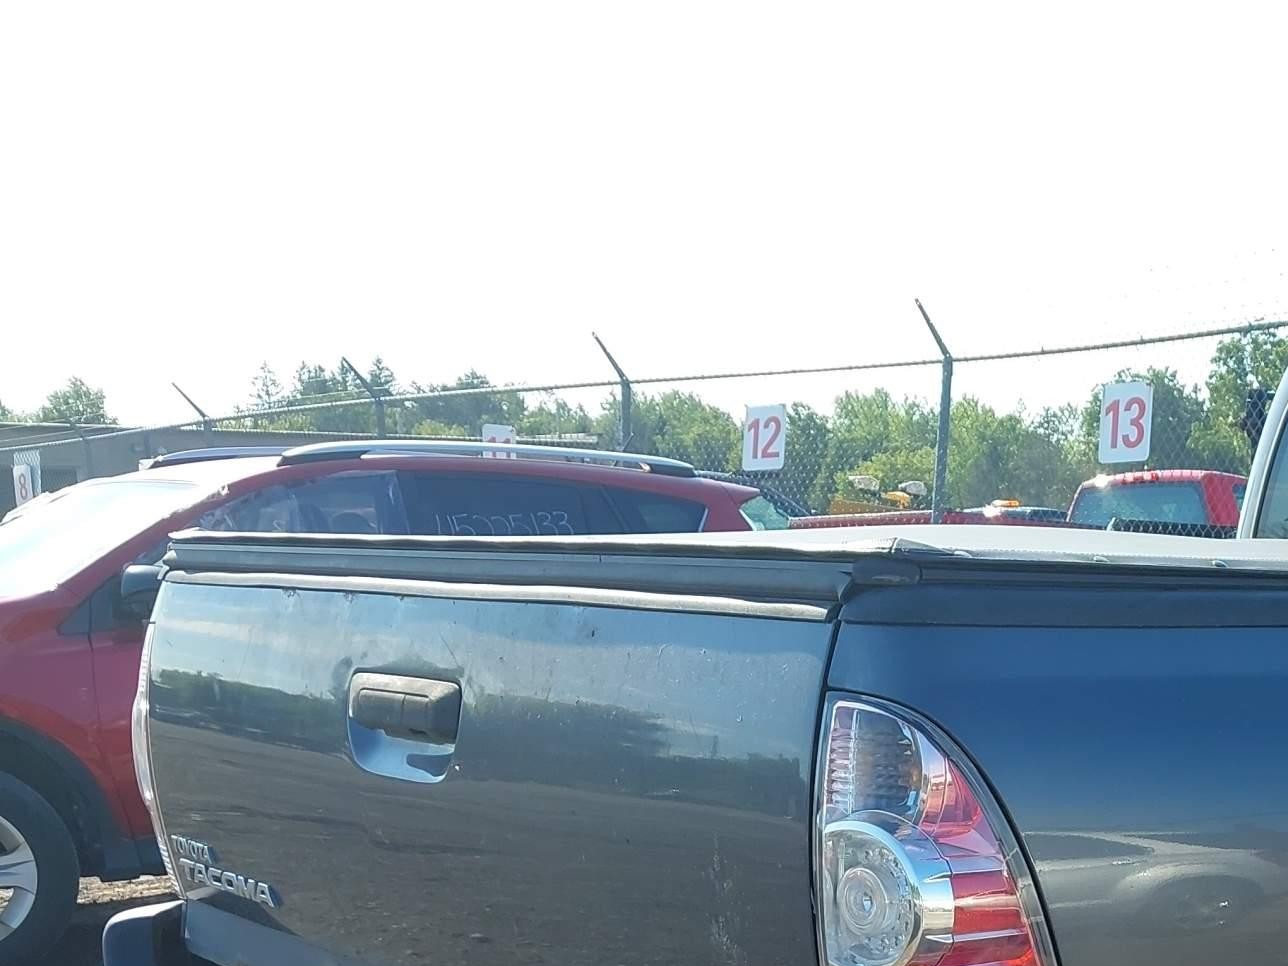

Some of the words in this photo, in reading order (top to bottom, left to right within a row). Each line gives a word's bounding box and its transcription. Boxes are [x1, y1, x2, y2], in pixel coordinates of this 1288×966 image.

[747, 415, 782, 460] 12
[1105, 396, 1146, 449] 13
[18, 473, 28, 500] 8
[170, 834, 213, 865] TOYOTA
[179, 857, 276, 908] TACOMA
